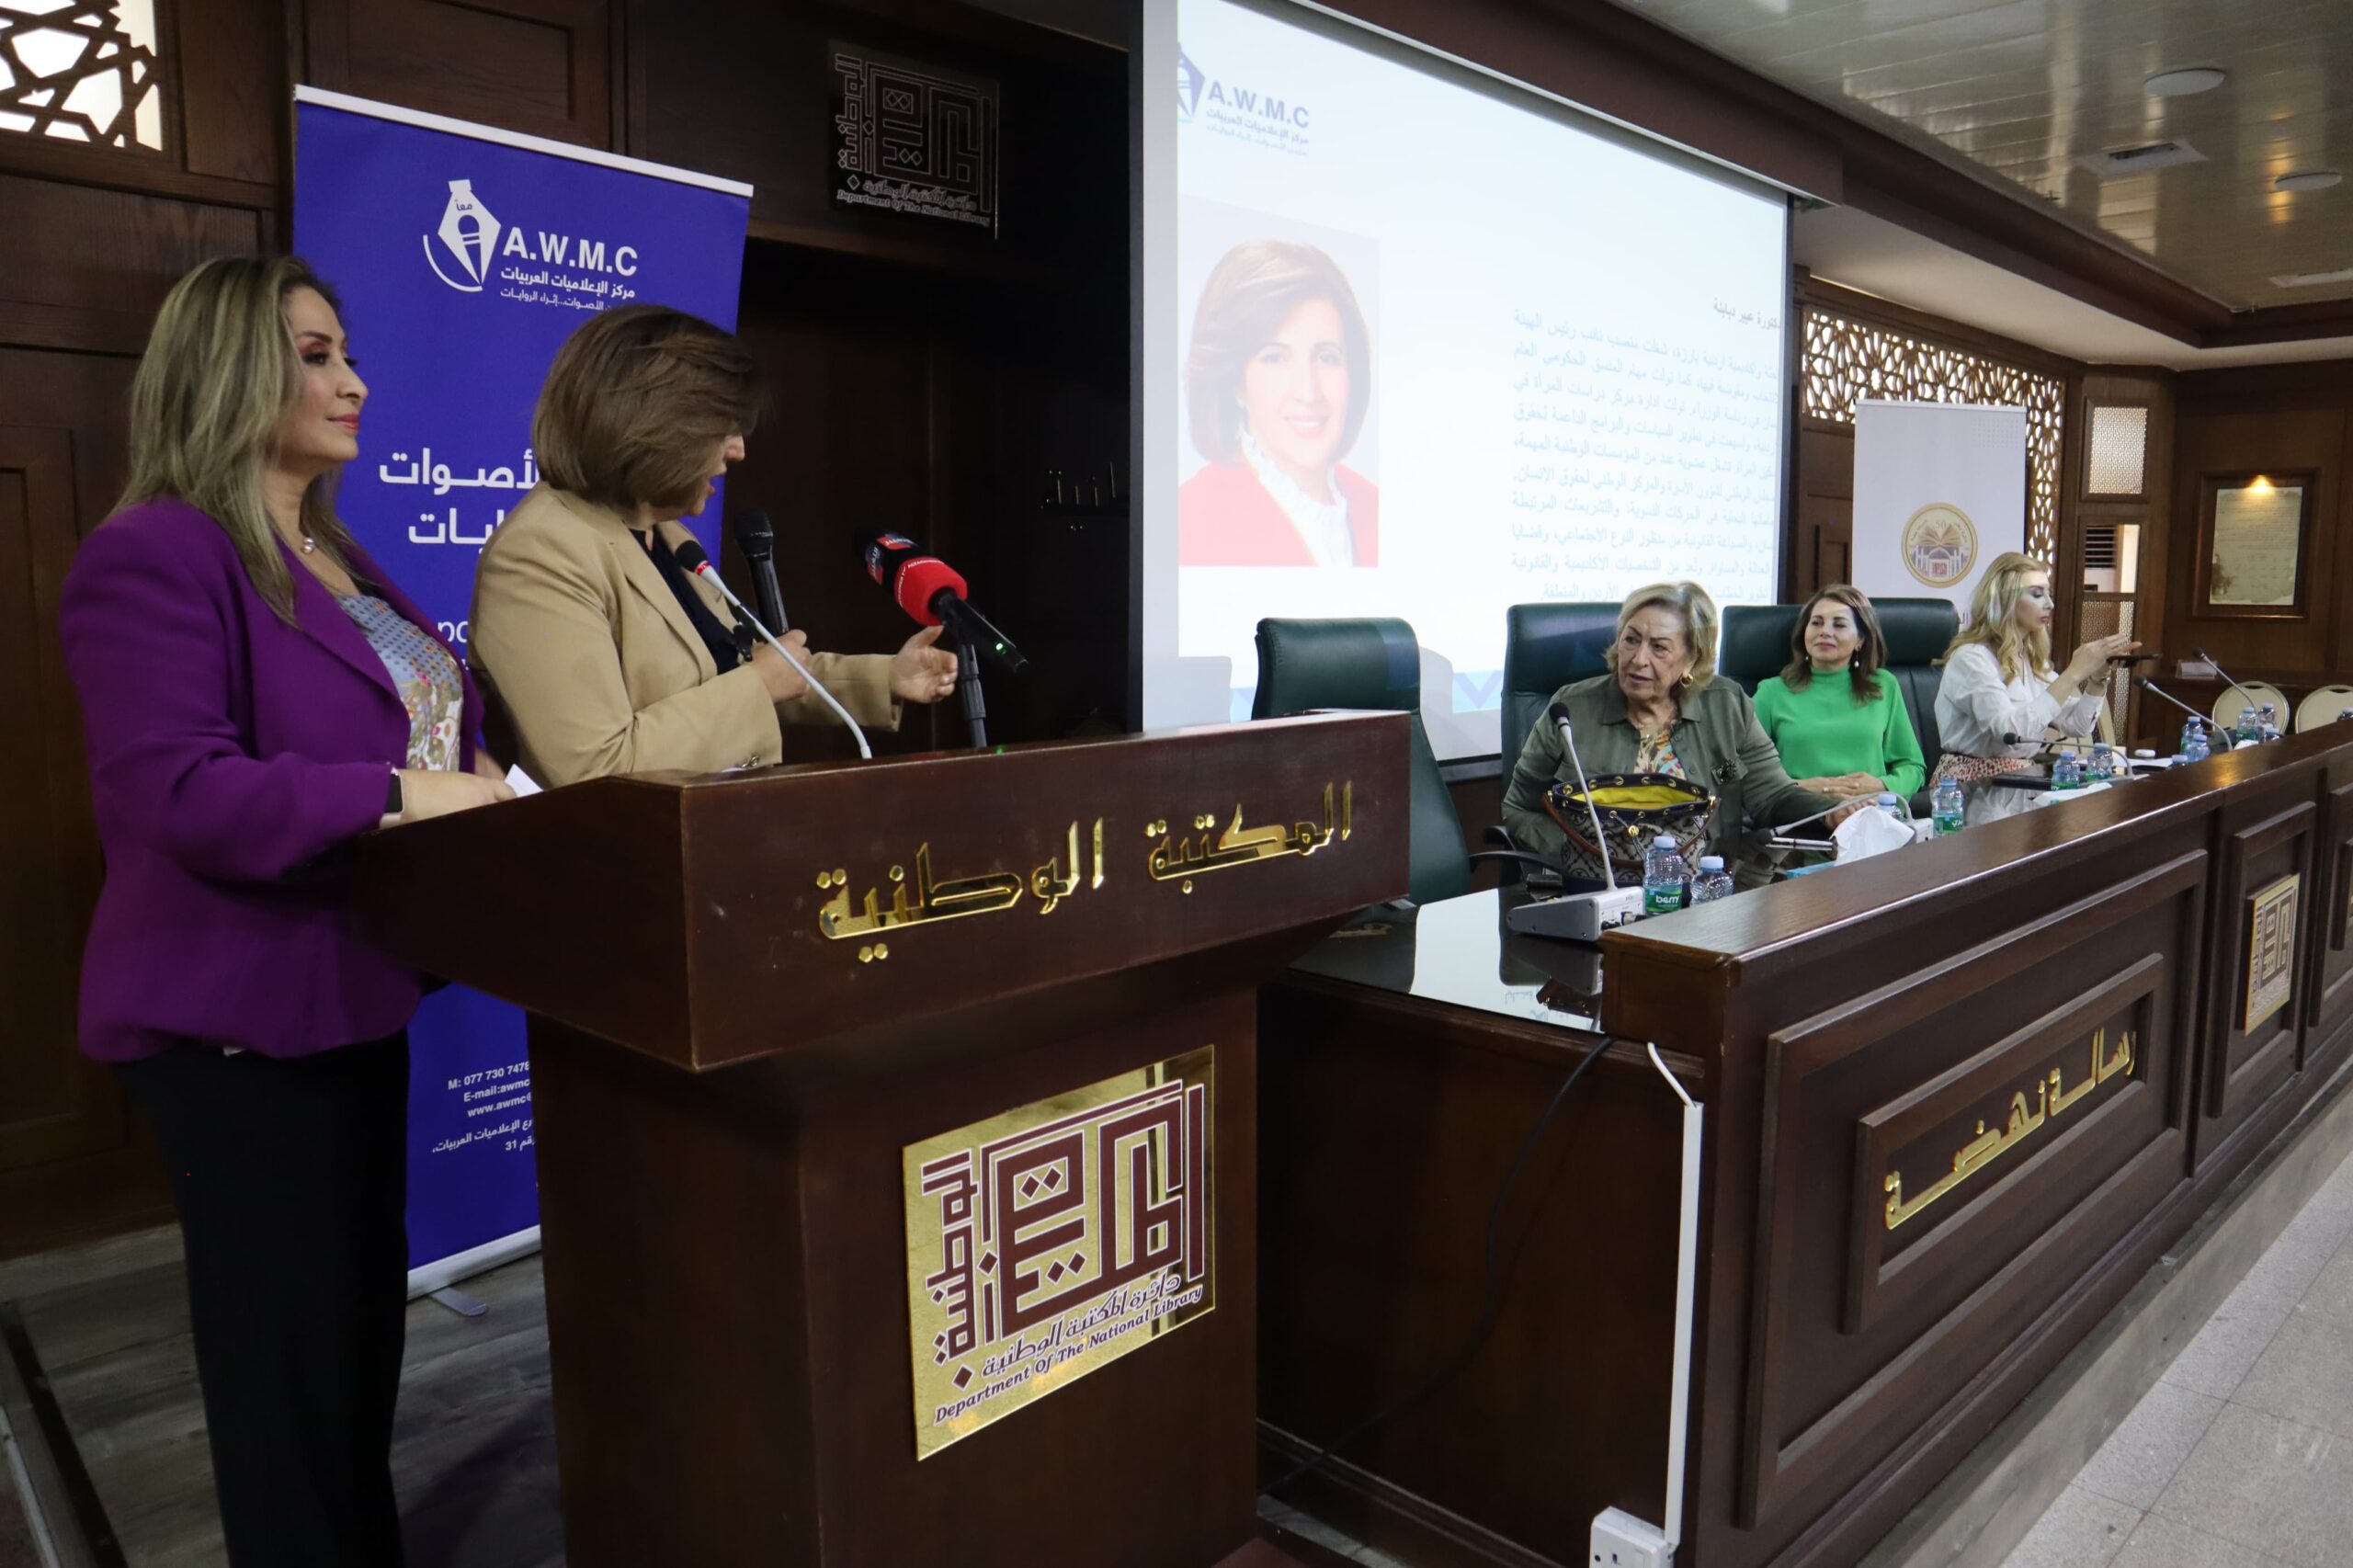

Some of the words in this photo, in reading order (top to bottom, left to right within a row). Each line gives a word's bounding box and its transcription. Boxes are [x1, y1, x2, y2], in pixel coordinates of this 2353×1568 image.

[1208, 80, 1309, 129] A.W.M.C
[836, 188, 891, 209] Department
[904, 199, 921, 213] The
[921, 204, 959, 222] National
[503, 226, 639, 277] A.W.M.C
[500, 287, 538, 302] الروايات
[501, 267, 549, 286] العربيات
[551, 274, 608, 297] الإعلاميات
[610, 283, 636, 301] مركز
[1145, 780, 1353, 895] المكتبة
[817, 816, 1104, 963] الوطنية
[448, 1078, 461, 1090] M:
[463, 1073, 483, 1085] 077
[485, 1067, 505, 1081] 730
[1129, 1271, 1182, 1310] دائرة
[1065, 1289, 1128, 1336] المكتبة
[934, 1367, 1030, 1426] Department
[1034, 1354, 1054, 1375] Of
[1058, 1343, 1085, 1364] The
[1088, 1312, 1151, 1348] National
[1153, 1284, 1204, 1317] Library
[981, 1315, 1063, 1378] الوطنية
